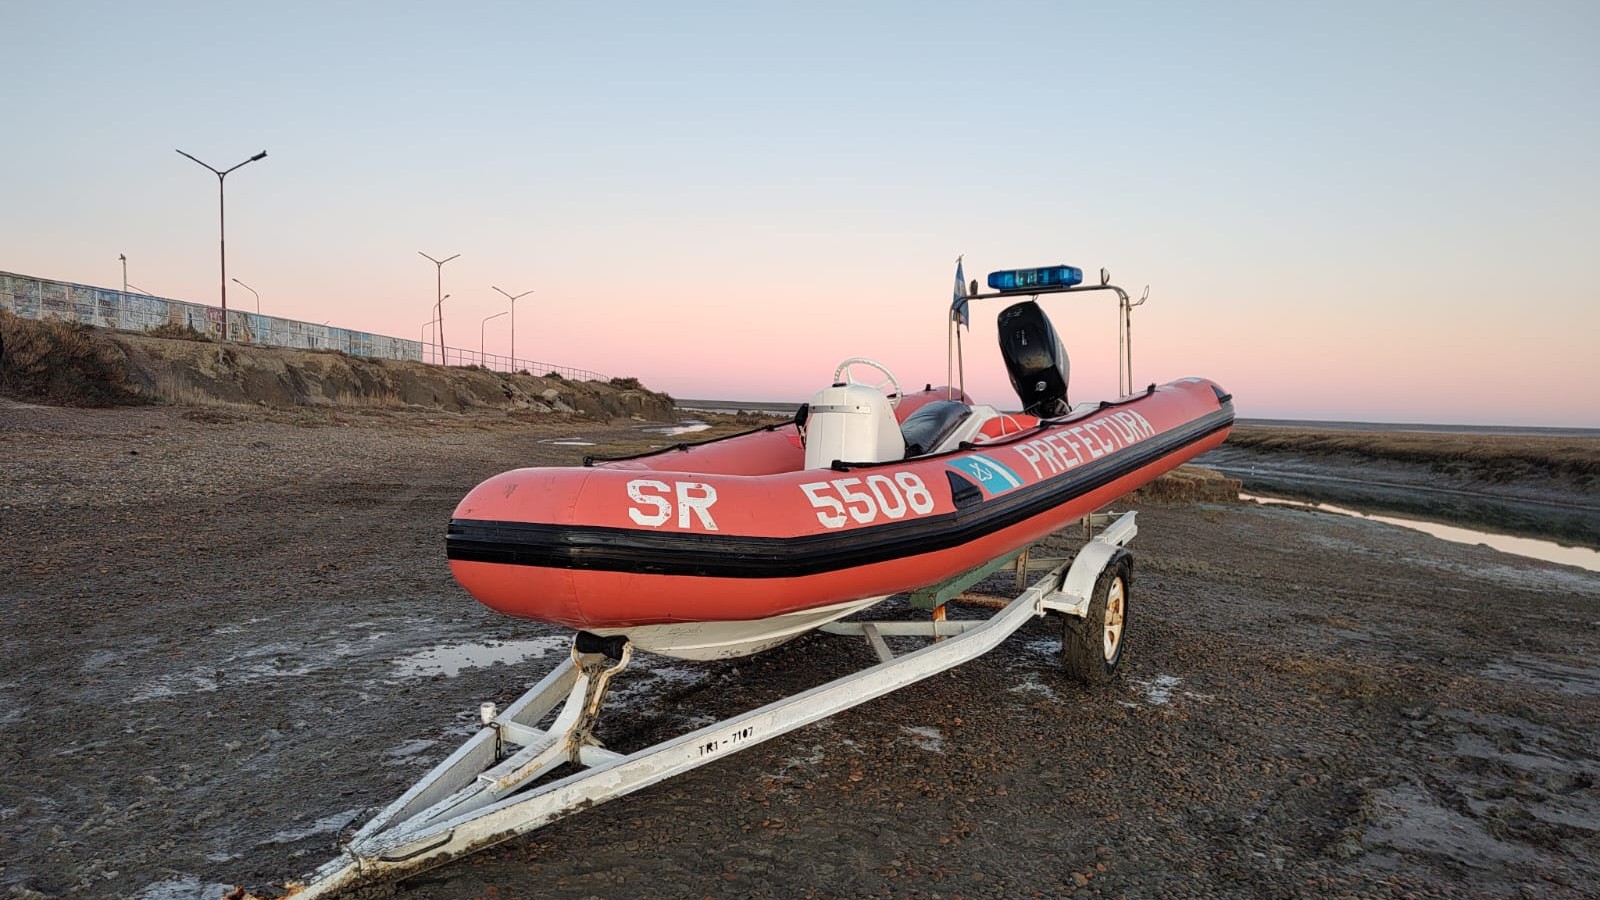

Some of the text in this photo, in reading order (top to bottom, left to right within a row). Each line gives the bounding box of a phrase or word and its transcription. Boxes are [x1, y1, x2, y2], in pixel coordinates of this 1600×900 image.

[1012, 408, 1155, 479] PREFECTURA
[626, 471, 935, 531] SR 5508
